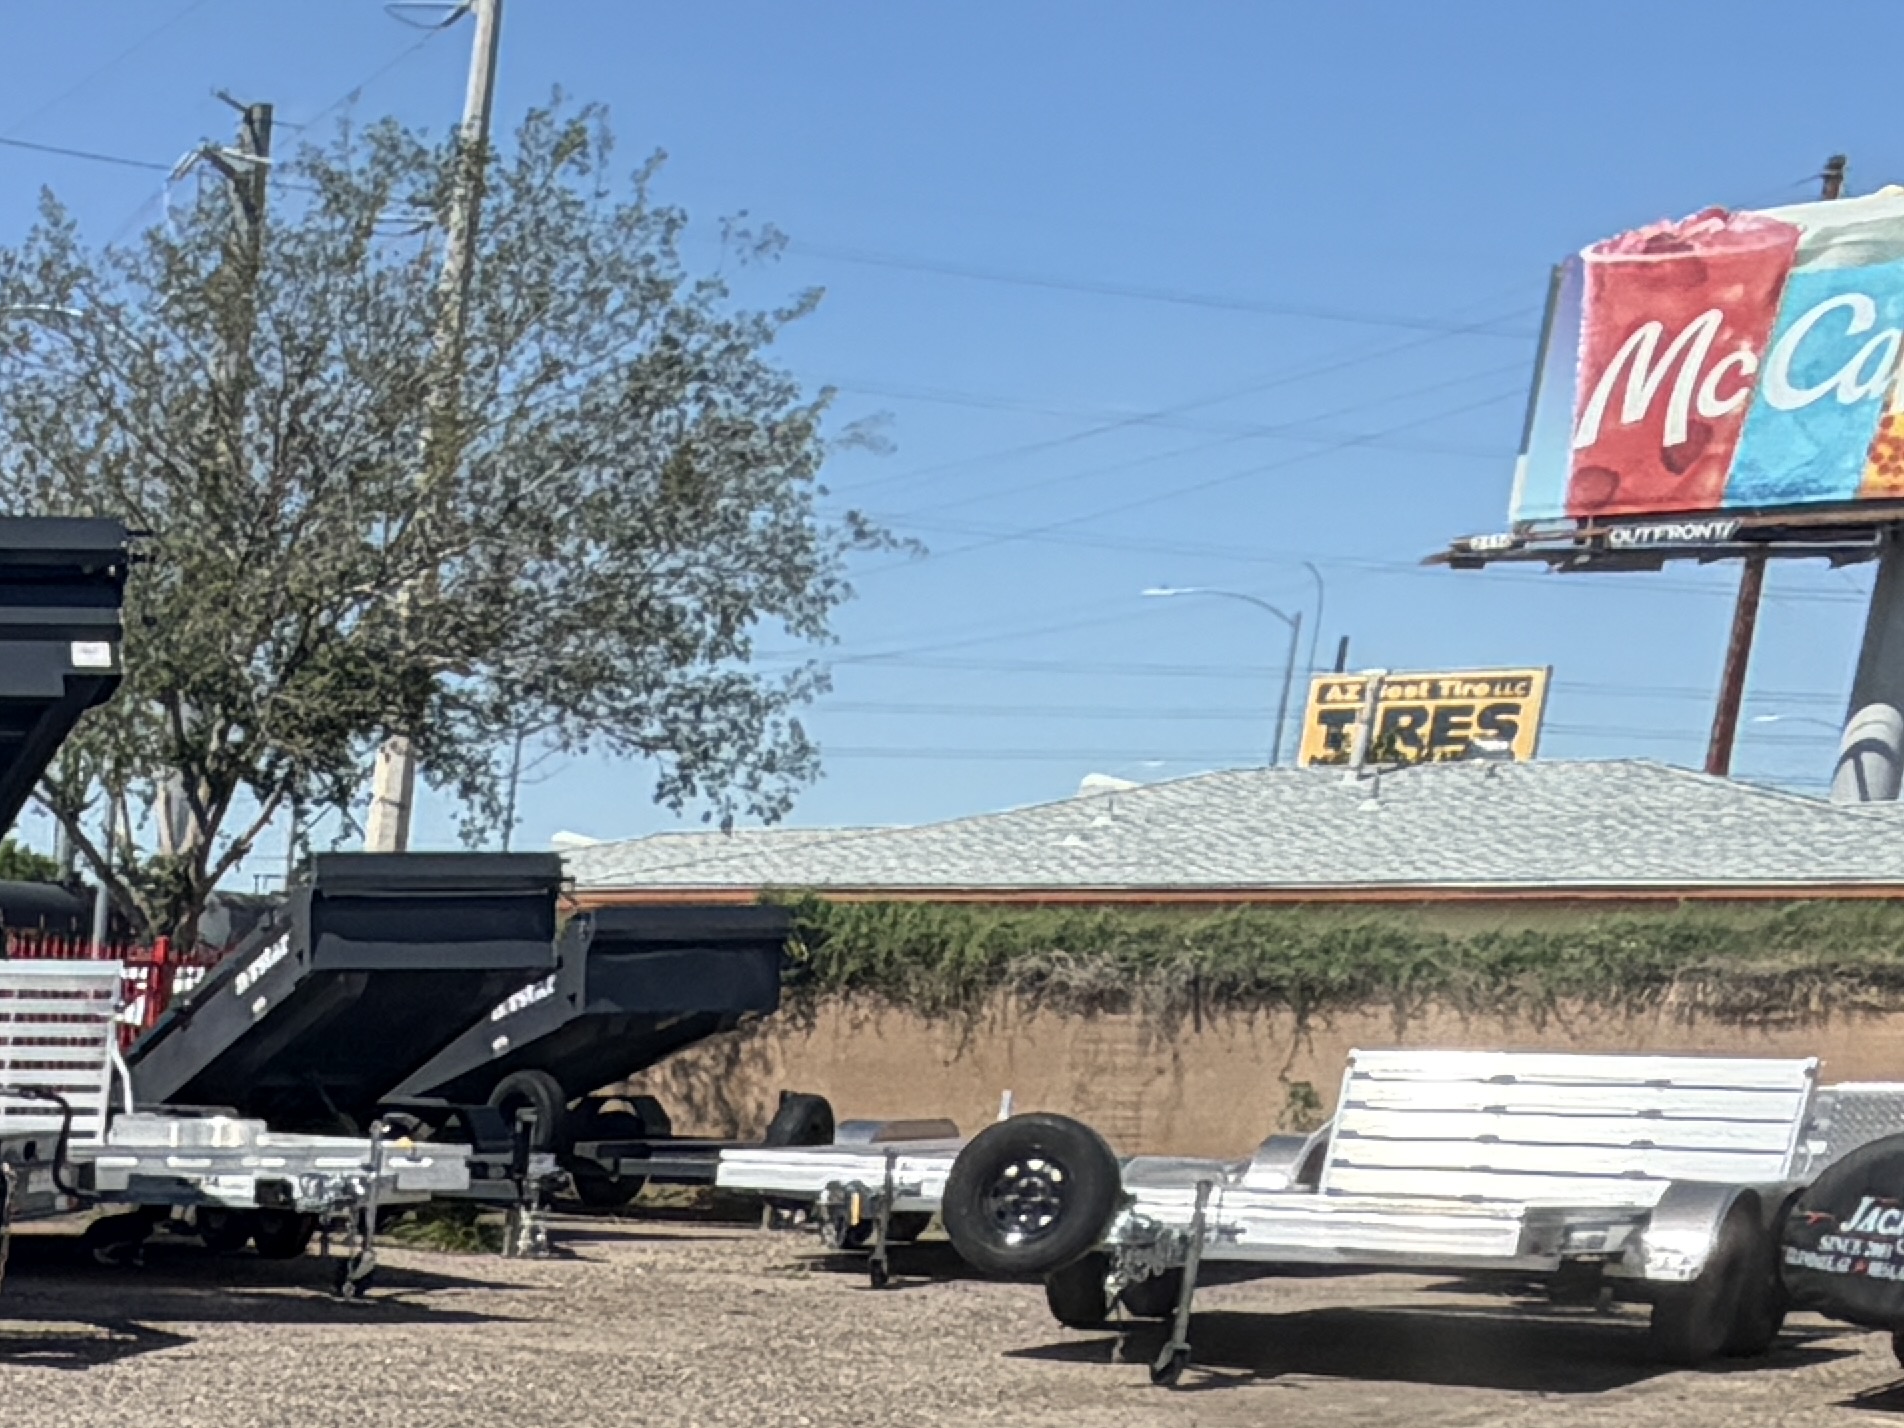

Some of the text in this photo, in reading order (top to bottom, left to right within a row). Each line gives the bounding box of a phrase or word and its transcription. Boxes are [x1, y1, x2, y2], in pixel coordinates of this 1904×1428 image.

[1573, 292, 1904, 449] McCa
[1317, 702, 1522, 752] TRES
[1839, 1196, 1904, 1236] JAC
